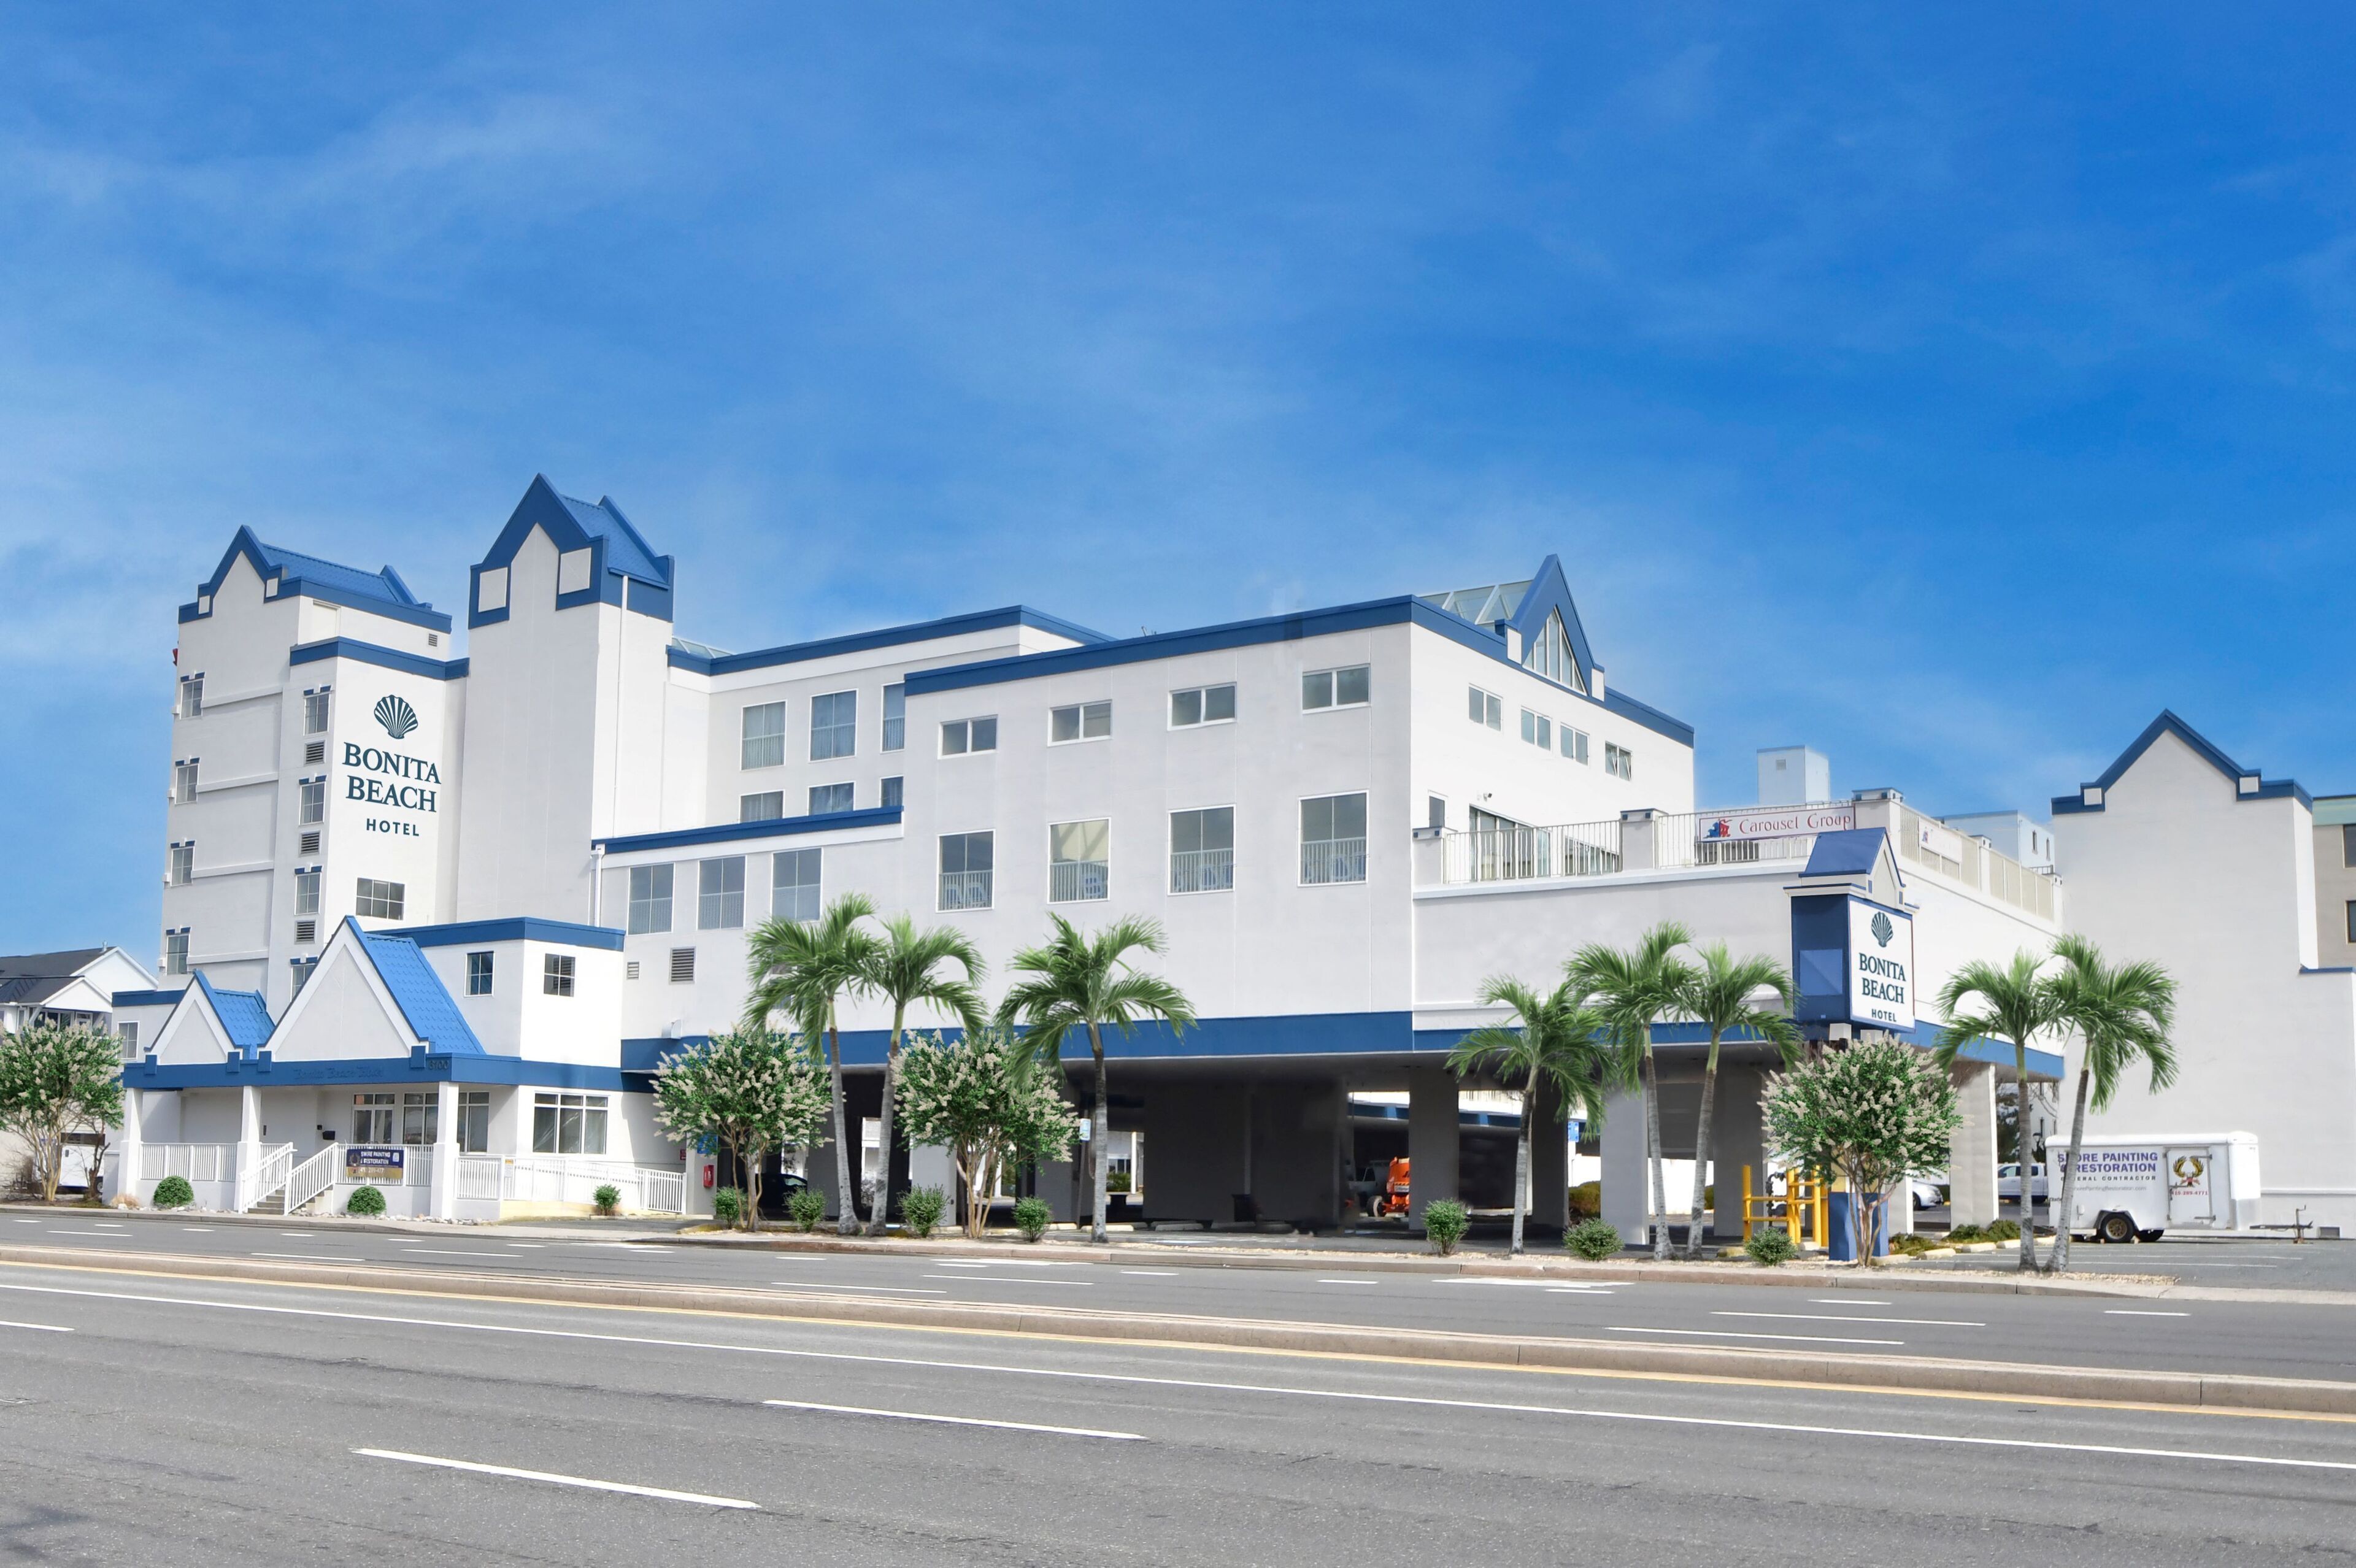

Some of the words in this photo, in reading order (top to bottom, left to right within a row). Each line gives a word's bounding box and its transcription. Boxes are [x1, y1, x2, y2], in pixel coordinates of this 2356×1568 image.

[342, 742, 442, 785] BONITA
[345, 775, 437, 812] BEACH
[366, 818, 419, 836] HOTEL
[1739, 815, 1799, 834] Carousel
[1807, 813, 1851, 831] Group
[1858, 953, 1906, 982] BONITA
[1861, 977, 1904, 1004] BEACH
[1871, 1009, 1897, 1022] HOTEL
[2057, 1153, 2098, 1163] SORE
[2103, 1152, 2158, 1162] PAINTING
